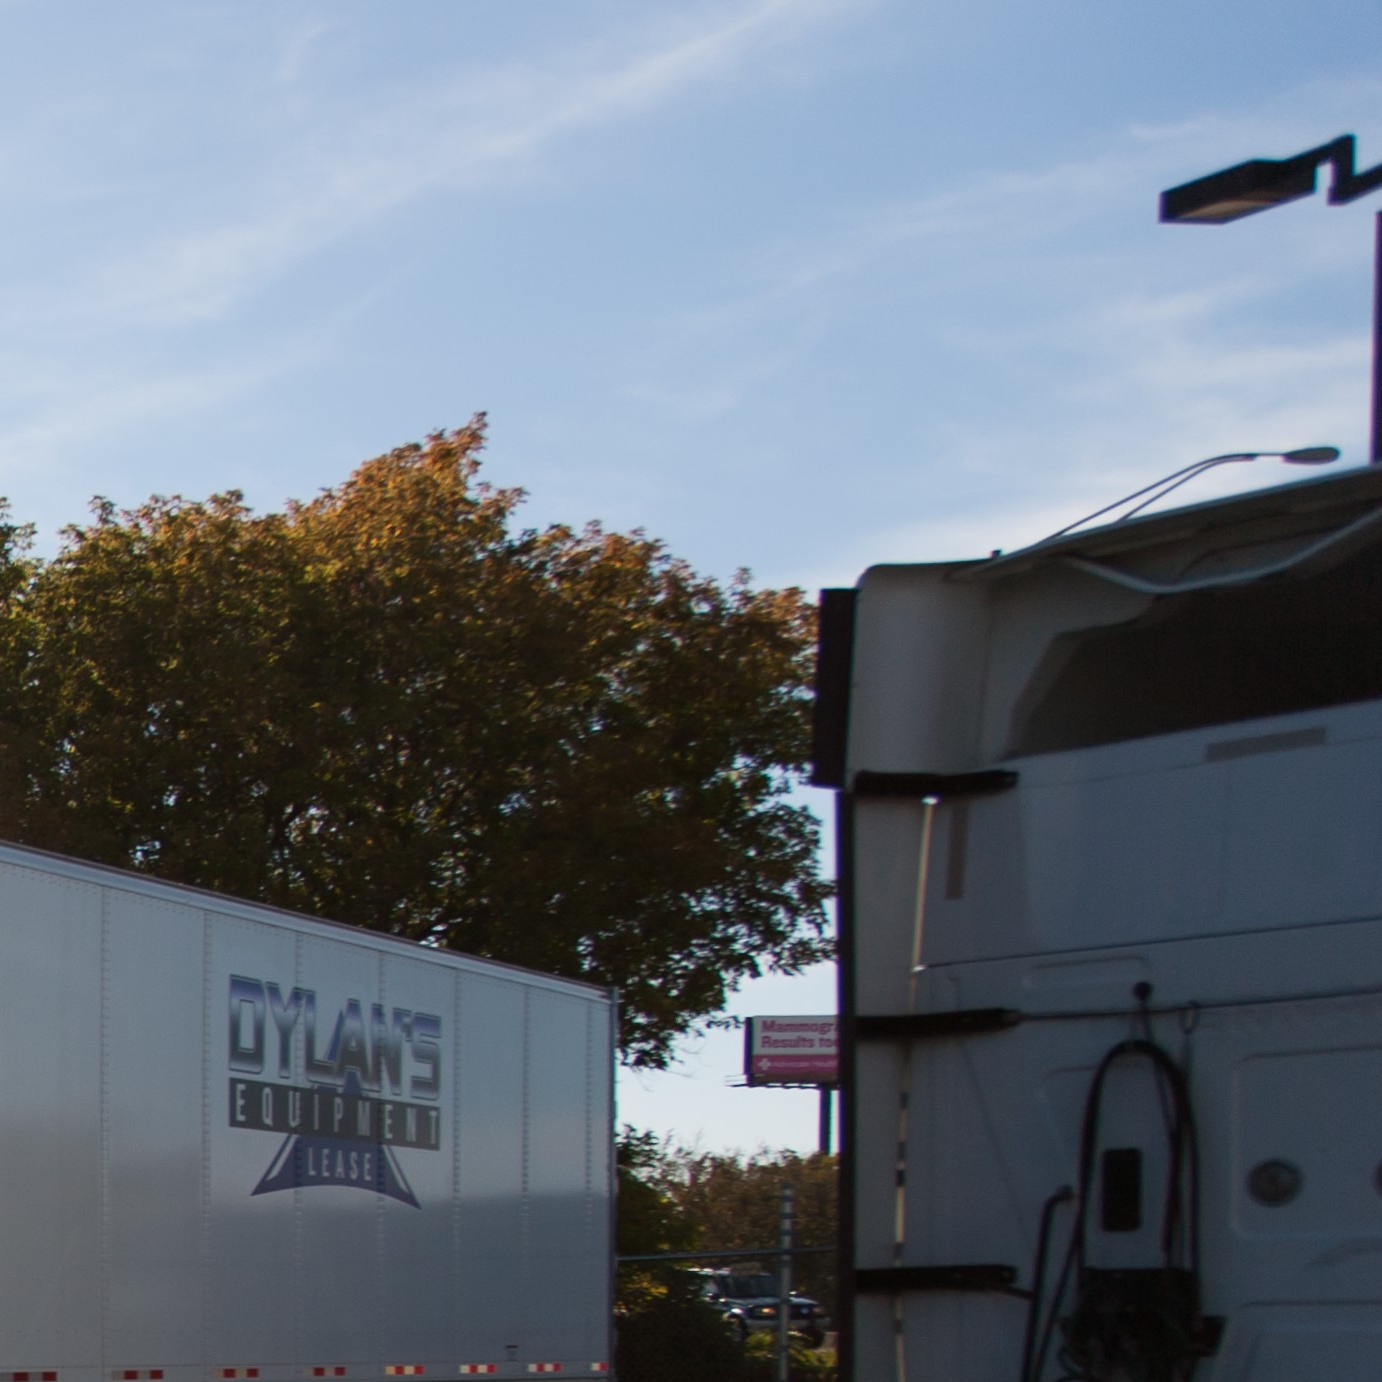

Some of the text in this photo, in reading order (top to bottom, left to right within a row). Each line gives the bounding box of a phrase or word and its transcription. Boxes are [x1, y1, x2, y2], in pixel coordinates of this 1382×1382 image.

[229, 974, 442, 1101] DYLAN'S
[761, 1035, 814, 1048] Results
[235, 1083, 438, 1145] EQUIPMENT
[308, 1148, 372, 1182] LEASE
